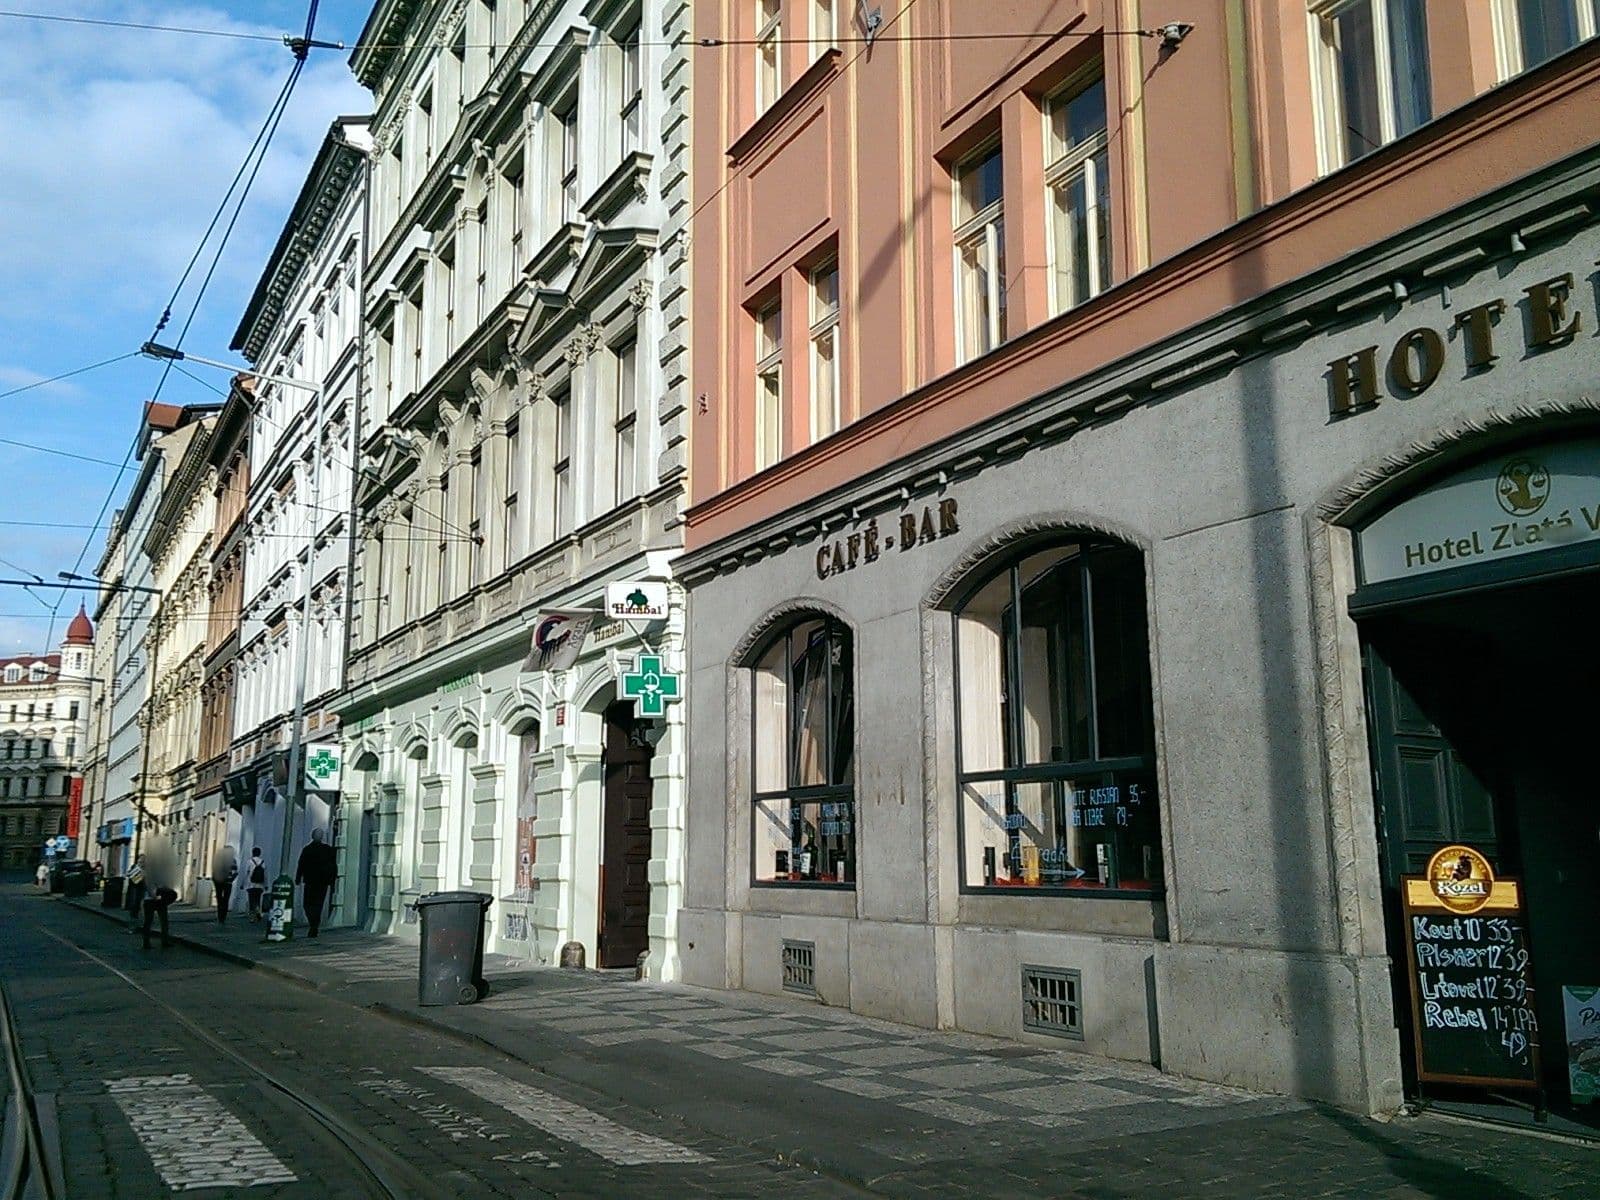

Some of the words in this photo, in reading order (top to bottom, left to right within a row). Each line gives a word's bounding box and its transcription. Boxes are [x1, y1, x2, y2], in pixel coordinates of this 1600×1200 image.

[1322, 270, 1600, 424] HOTE
[1404, 530, 1485, 569] Hotel
[1490, 509, 1575, 552] Zlatá
[1437, 879, 1488, 897] Kozel
[1413, 915, 1464, 940] Kout
[1424, 1000, 1488, 1031] Rebel
[1511, 1006, 1539, 1032] IPA
